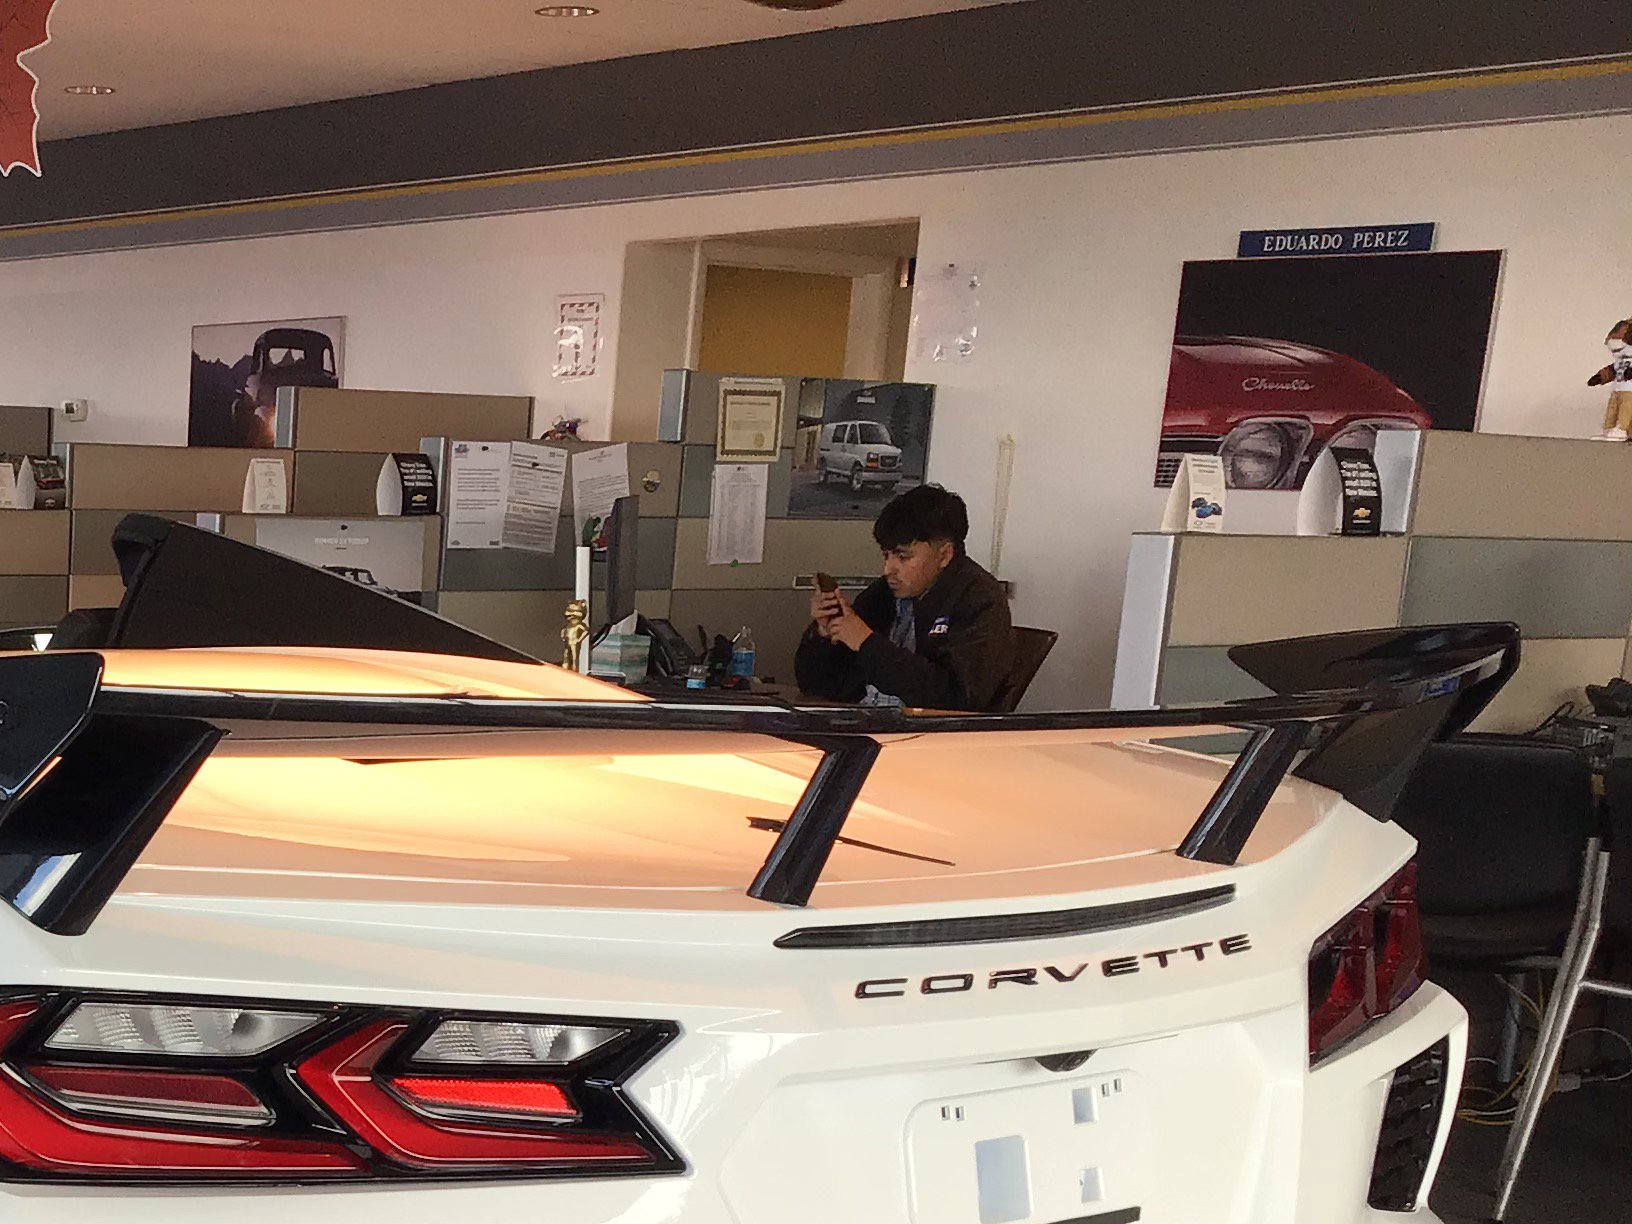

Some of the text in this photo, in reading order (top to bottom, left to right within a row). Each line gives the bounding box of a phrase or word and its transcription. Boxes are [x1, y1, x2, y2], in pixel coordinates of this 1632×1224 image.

[1263, 230, 1410, 252] EDUARDO PEREZ
[854, 933, 1253, 999] CORVETTE
